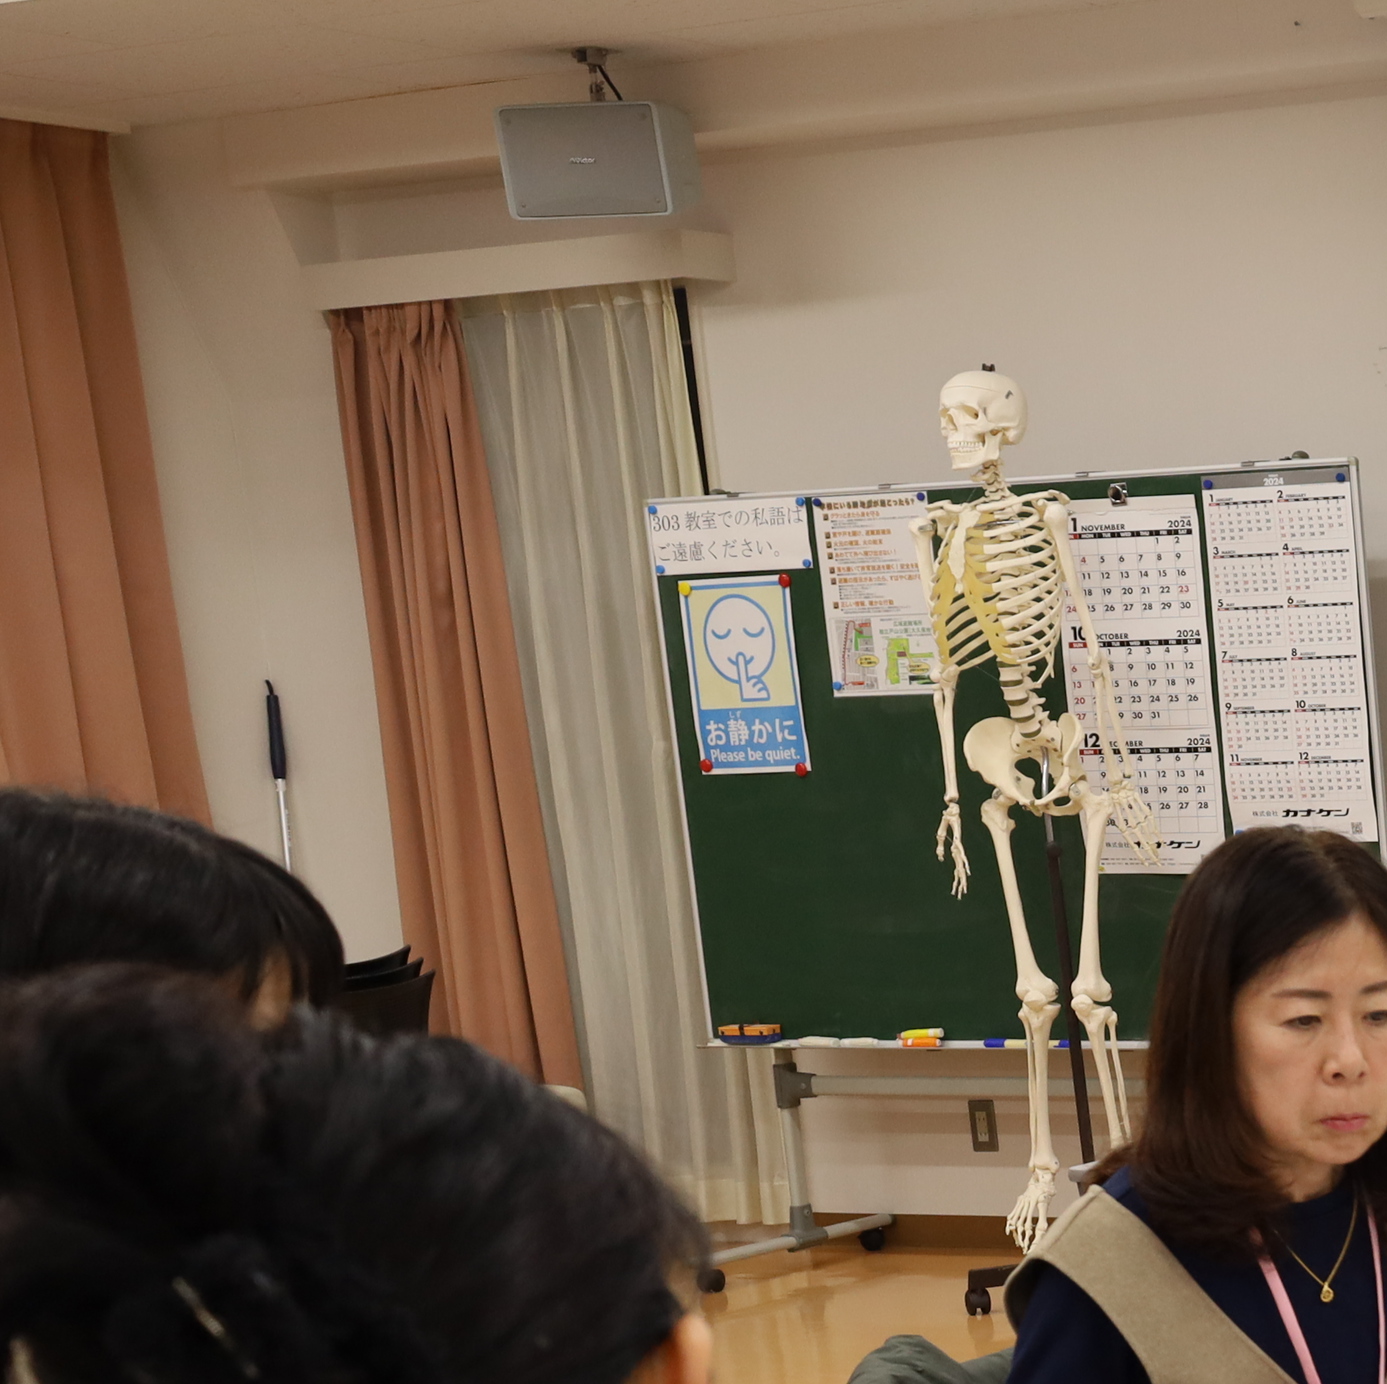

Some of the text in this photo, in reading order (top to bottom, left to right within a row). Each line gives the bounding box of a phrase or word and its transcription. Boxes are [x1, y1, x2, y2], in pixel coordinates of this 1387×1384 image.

[1263, 478, 1284, 486] 2024
[1209, 494, 1213, 502] 1
[1277, 490, 1283, 498] 2
[653, 507, 804, 531] 303 教室での私語は
[1168, 520, 1192, 528] 2024
[658, 539, 780, 561] ご遠慮ください。
[1213, 547, 1219, 555] 3
[1283, 543, 1289, 551] 4
[1287, 596, 1294, 604] 6
[1222, 651, 1227, 659] 7
[1291, 648, 1297, 656] 8
[1296, 700, 1306, 708] 10
[705, 719, 797, 746] お静かに
[1084, 733, 1099, 747] 12
[710, 746, 800, 763] Please be quiet.
[1230, 754, 1239, 762] 11
[1299, 752, 1309, 760] 12
[1282, 808, 1349, 817] カナケン
